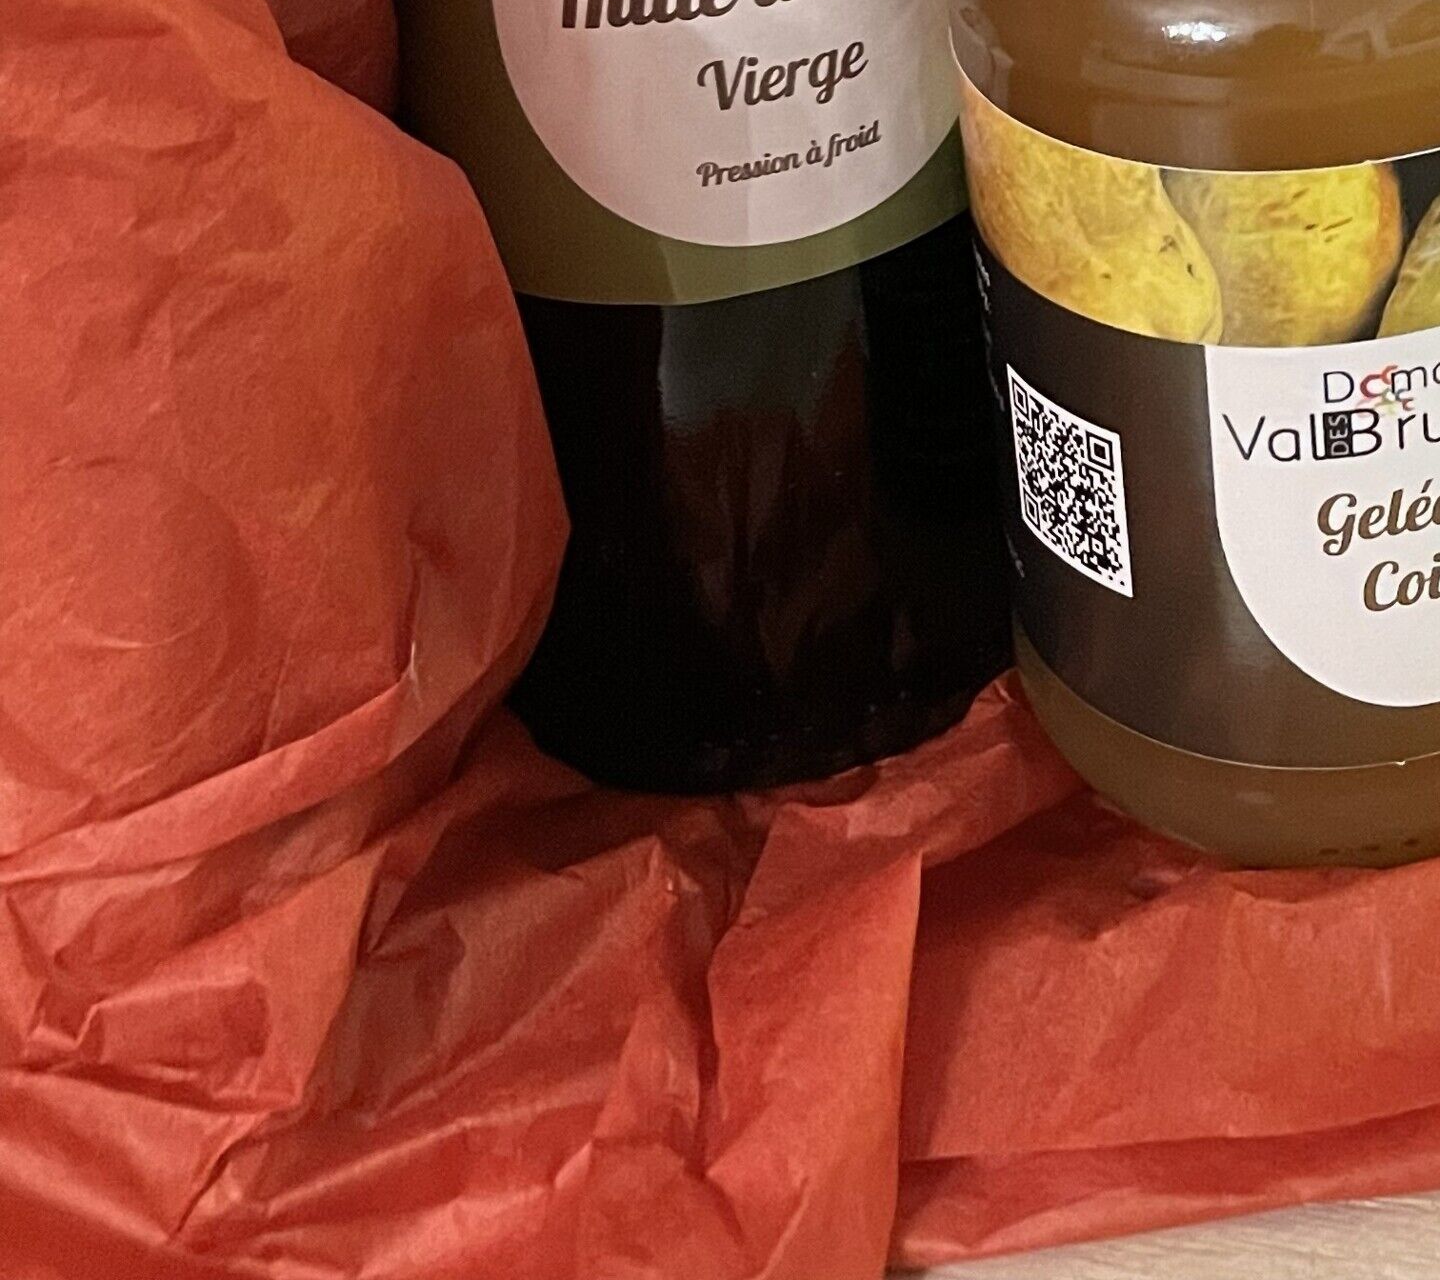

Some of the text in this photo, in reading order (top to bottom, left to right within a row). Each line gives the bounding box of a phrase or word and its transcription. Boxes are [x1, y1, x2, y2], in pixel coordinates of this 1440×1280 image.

[697, 40, 869, 111] Vierge
[696, 119, 882, 187] Pression à froid
[1223, 410, 1322, 462] Val
